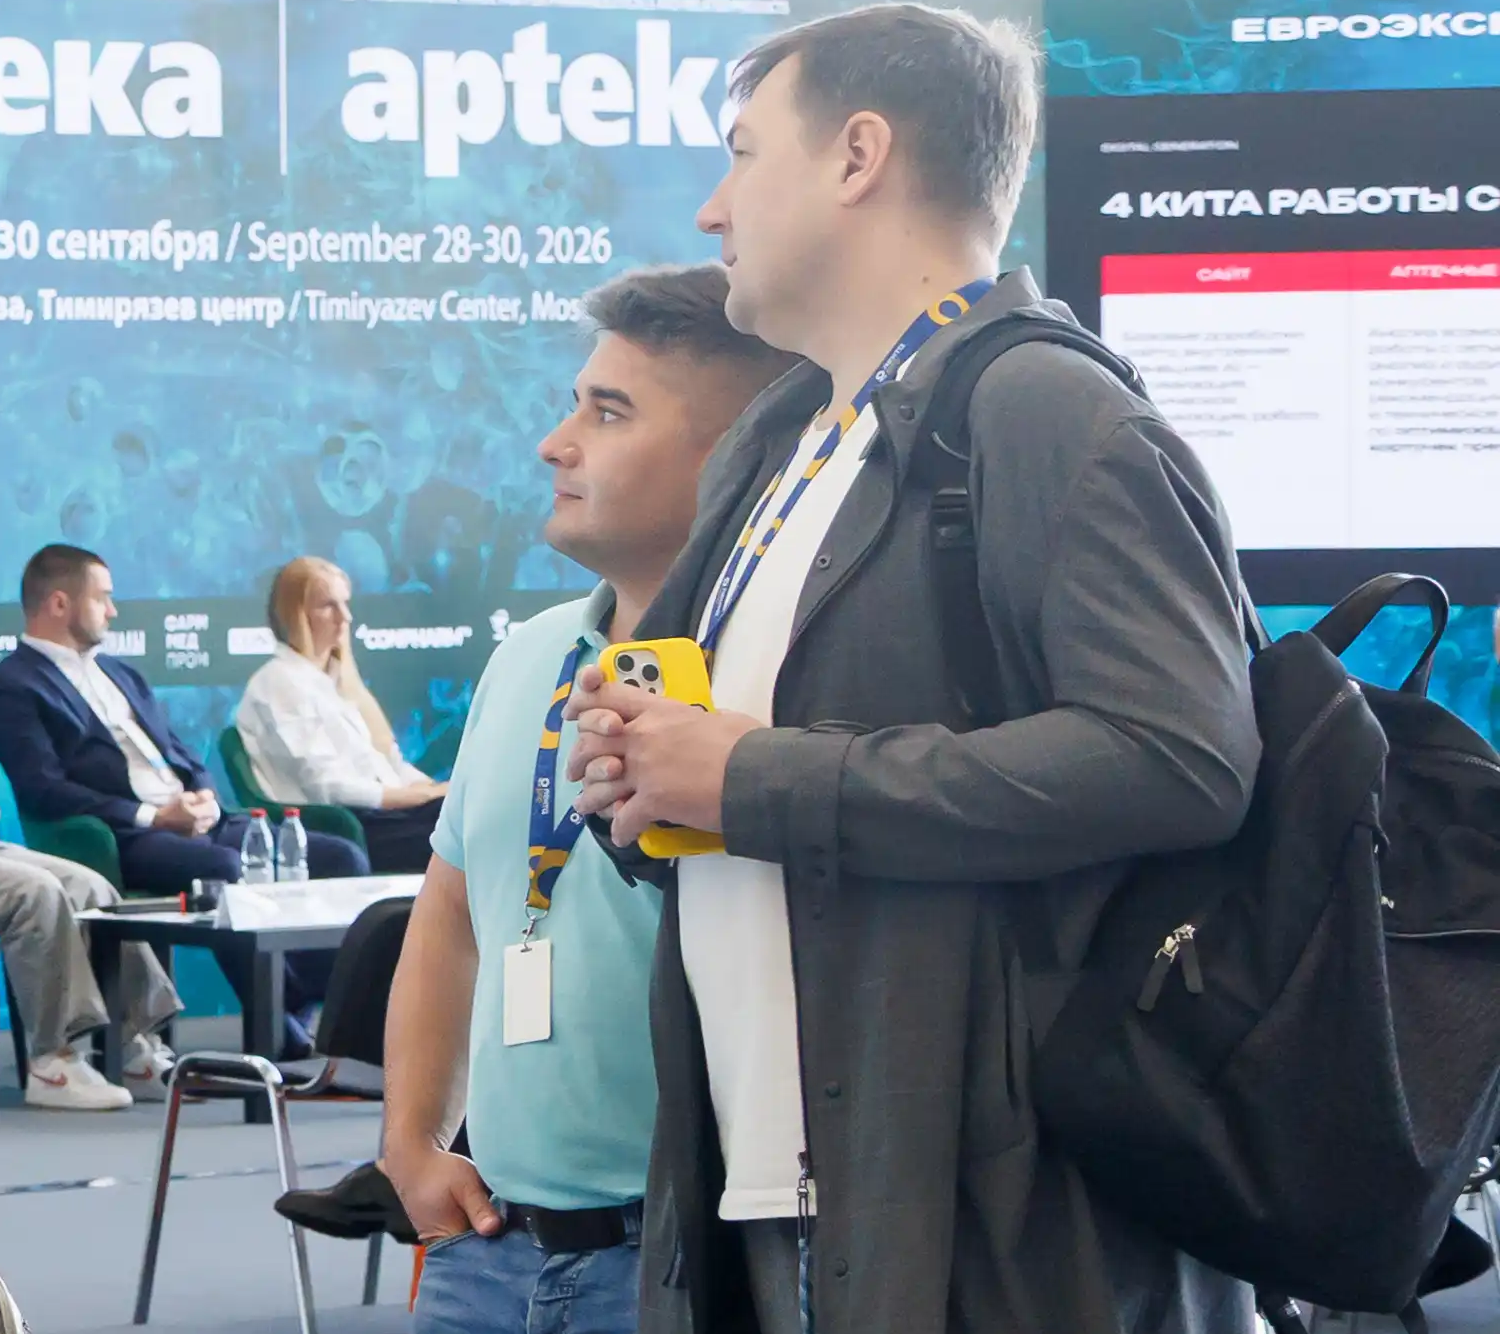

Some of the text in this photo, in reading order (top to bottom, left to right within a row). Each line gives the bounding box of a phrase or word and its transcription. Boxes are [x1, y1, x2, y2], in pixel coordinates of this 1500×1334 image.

[1100, 192, 1134, 218] 4
[1139, 188, 1264, 218] КИТА
[1268, 184, 1459, 216] РАБОТЫ
[47, 219, 218, 271] сентября
[248, 221, 425, 270] September
[432, 224, 530, 268] 28-30,
[536, 225, 612, 263] 2026
[38, 288, 198, 328] Тимирязев
[202, 296, 285, 329] центр
[305, 289, 437, 329] Timiryazev
[440, 290, 528, 326] Center,
[532, 291, 592, 323] Mos
